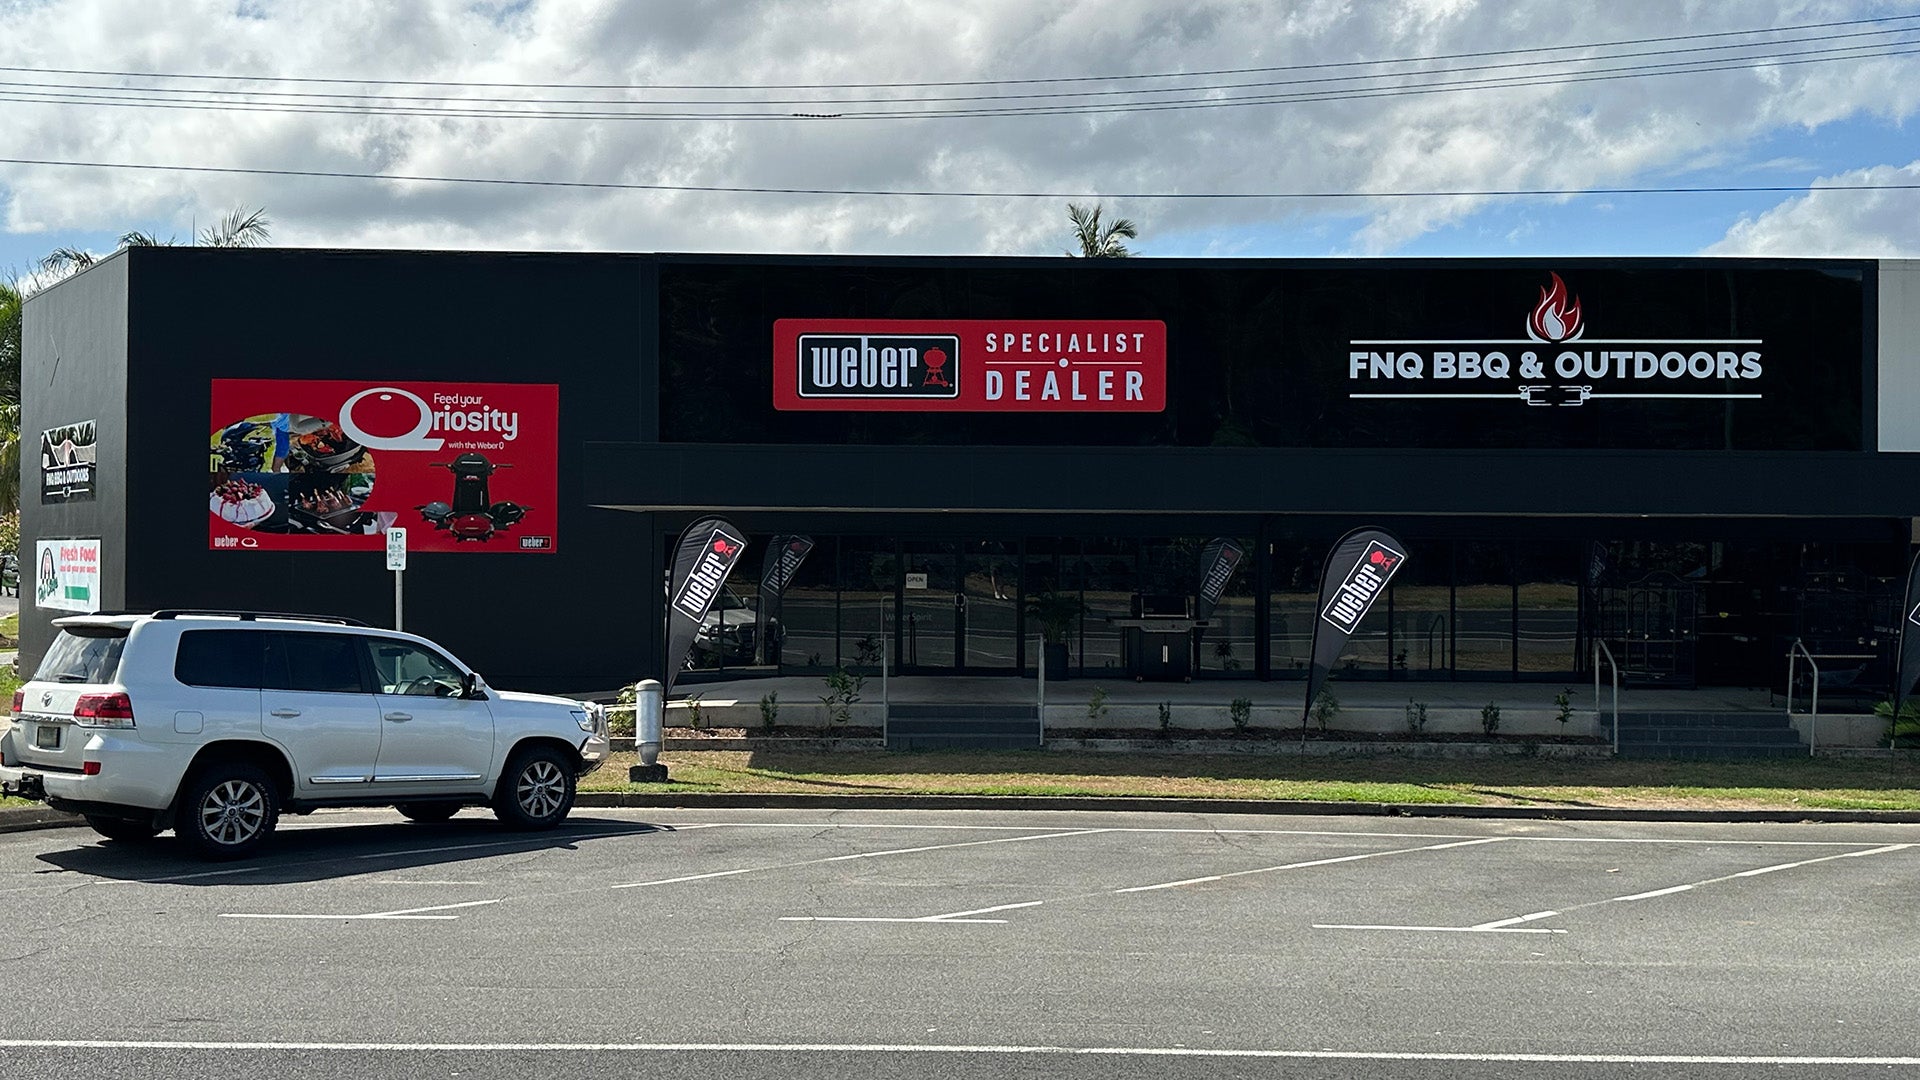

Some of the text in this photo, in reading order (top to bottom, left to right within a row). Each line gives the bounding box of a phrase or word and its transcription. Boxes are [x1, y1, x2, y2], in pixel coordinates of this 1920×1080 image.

[985, 333, 1145, 353] SPECIALIST
[811, 336, 918, 388] weber
[1349, 351, 1762, 379] FNQ BBQ & OUTDOORS
[985, 370, 1145, 401] DEALER
[433, 393, 483, 408] Feed your
[448, 441, 464, 449] with
[464, 441, 476, 449] the
[476, 441, 498, 449] Weber
[214, 534, 239, 547] weber
[390, 531, 403, 542] 1P
[522, 536, 544, 547] weber
[60, 545, 97, 562] Fresh Food
[680, 552, 726, 613] weber
[1330, 564, 1383, 625] weber
